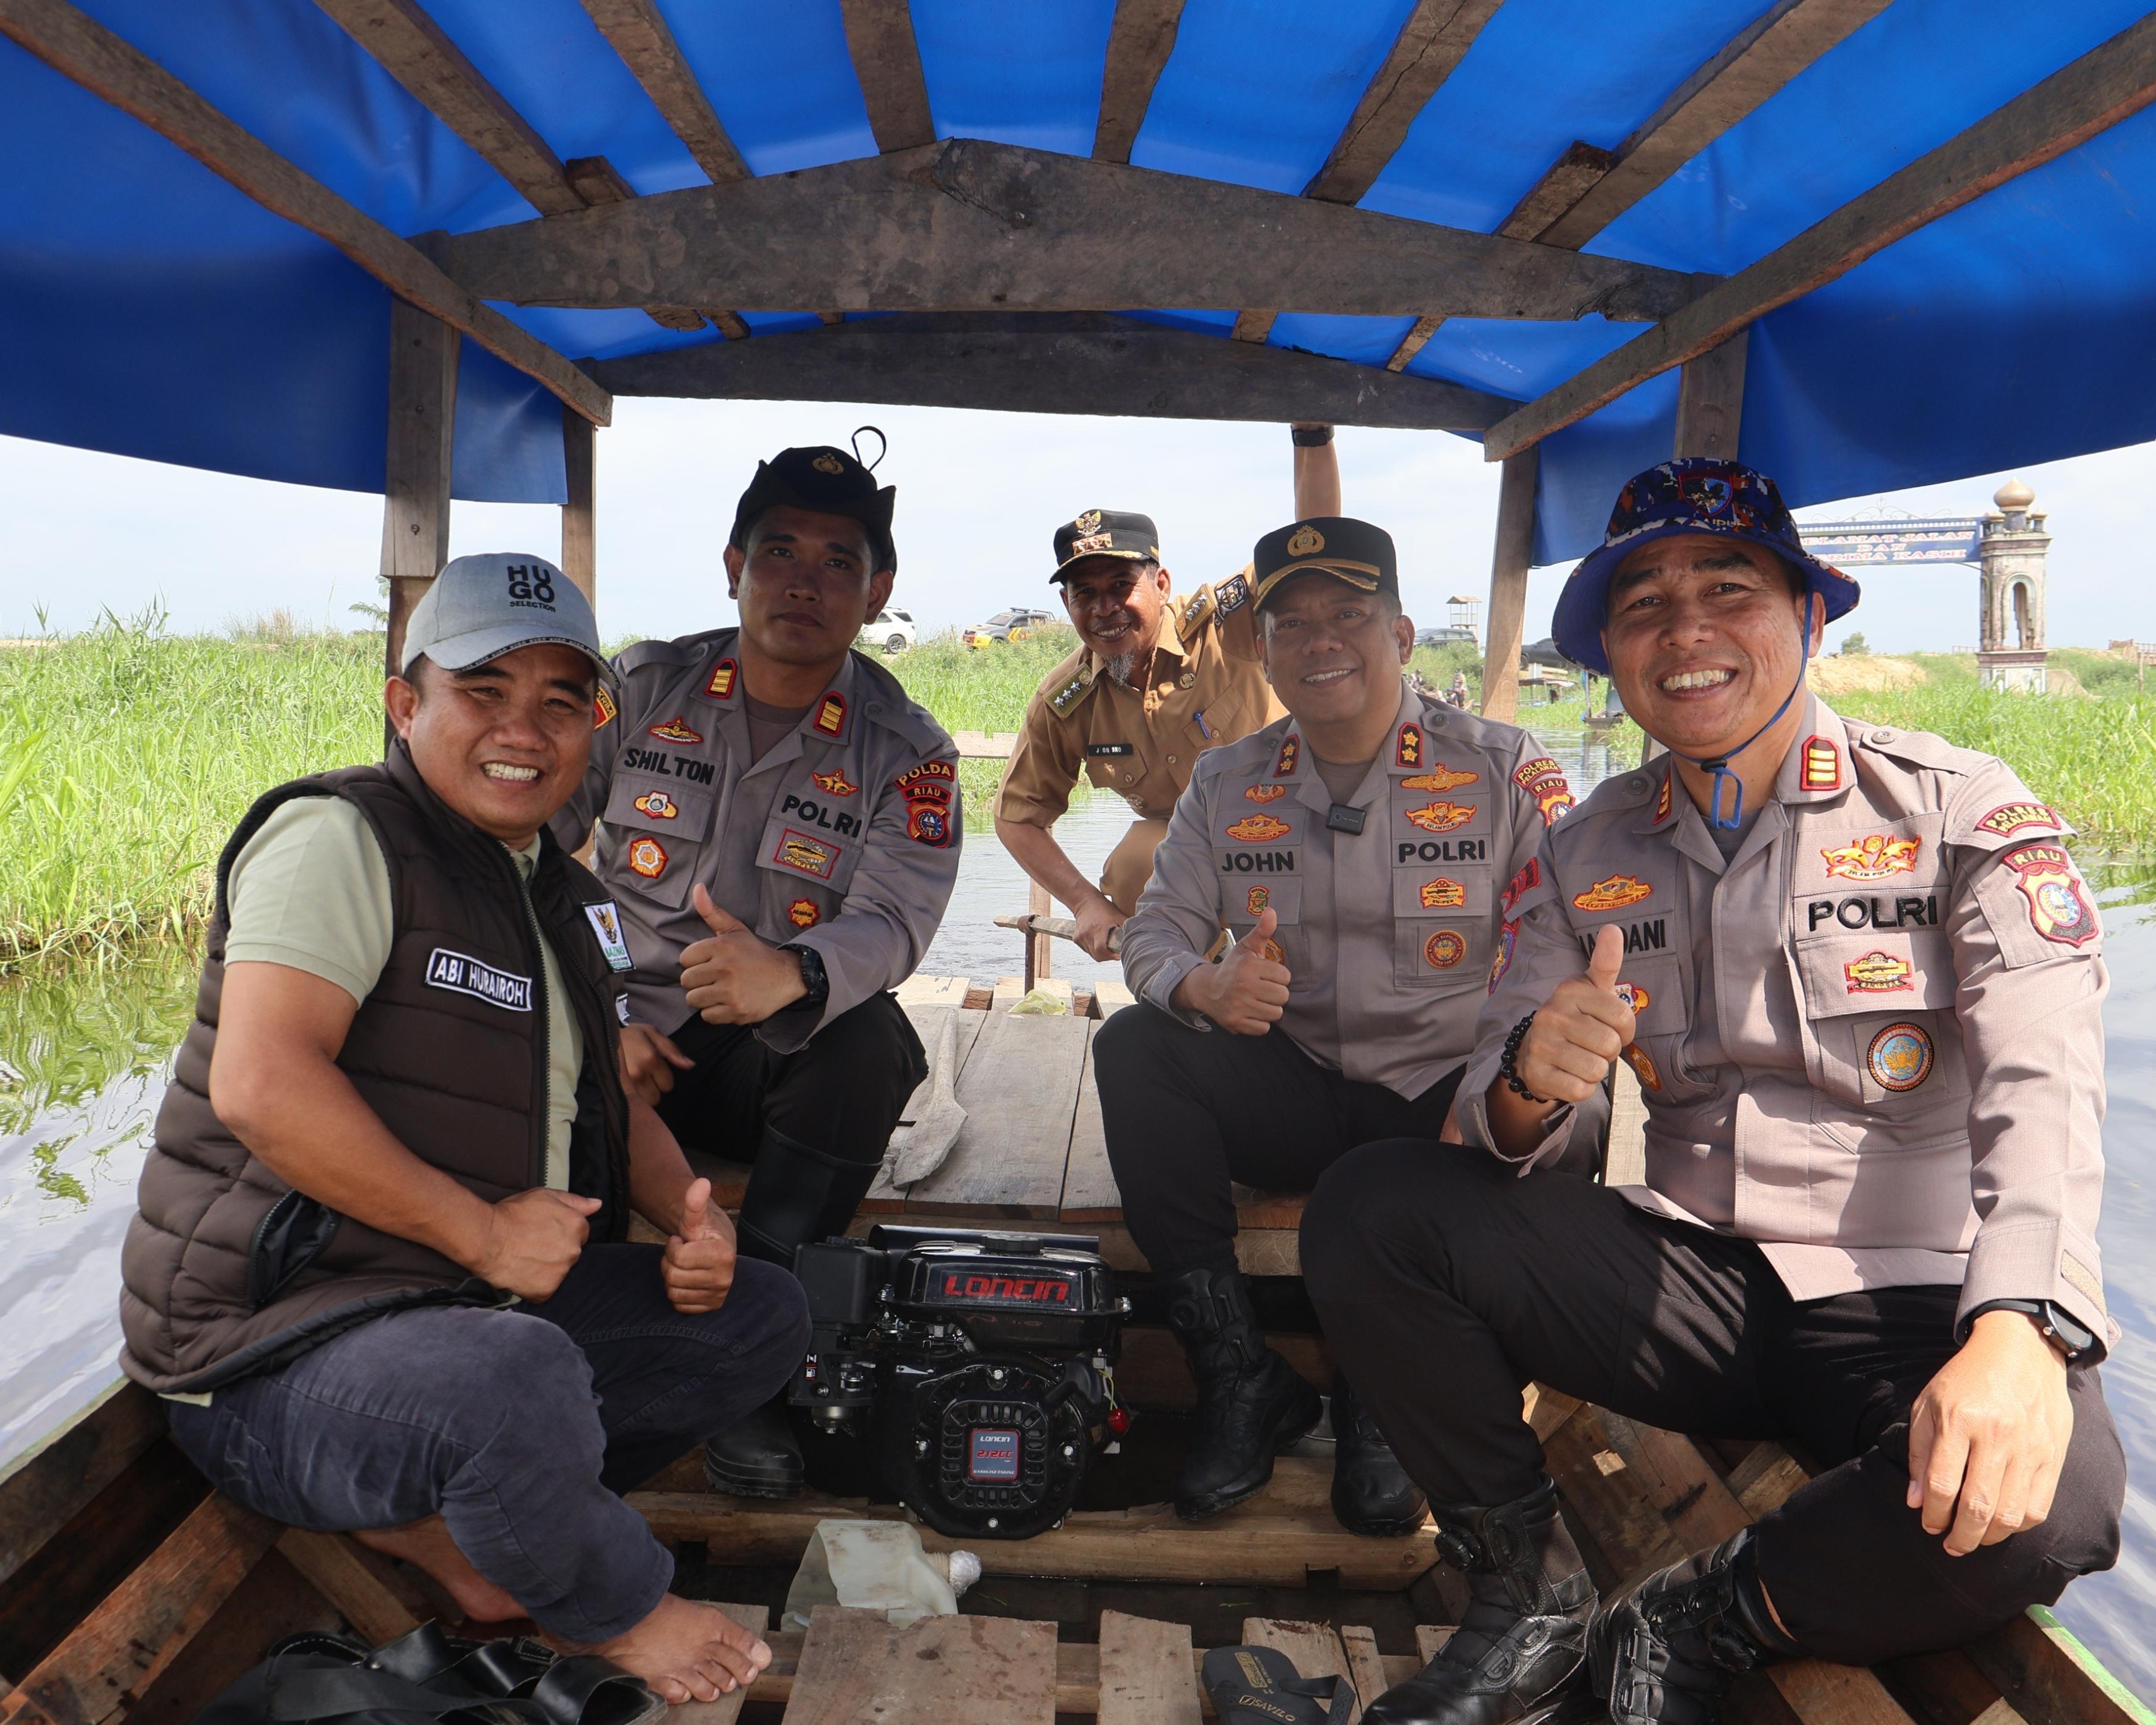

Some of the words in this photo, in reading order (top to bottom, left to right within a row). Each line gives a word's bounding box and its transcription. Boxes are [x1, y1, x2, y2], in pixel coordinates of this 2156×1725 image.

[1801, 533, 1898, 545] ELAMAT
[1900, 531, 1975, 542] JALAN
[1857, 543, 1906, 552] DAN
[1893, 549, 1967, 560] KASIH
[509, 601, 555, 612] SELECTION
[624, 748, 715, 785] SHILTON
[899, 764, 951, 786] POLDA
[1518, 760, 1555, 780] POLRES
[1522, 765, 1559, 785] PELALAWAN
[914, 787, 941, 797] RIAU
[1535, 780, 1563, 792] RIAU
[781, 794, 863, 838] POLRI
[1985, 806, 2049, 828] POLRES
[1222, 850, 1294, 872] JOHN
[1398, 839, 1486, 863] POLRI
[2014, 849, 2060, 865] RIAU
[1808, 895, 1938, 931] POLRI
[434, 956, 464, 984] ABI
[469, 964, 524, 1005] HURAIROH
[945, 1275, 1069, 1300] LONCIN
[976, 1450, 1013, 1459] 212CC
